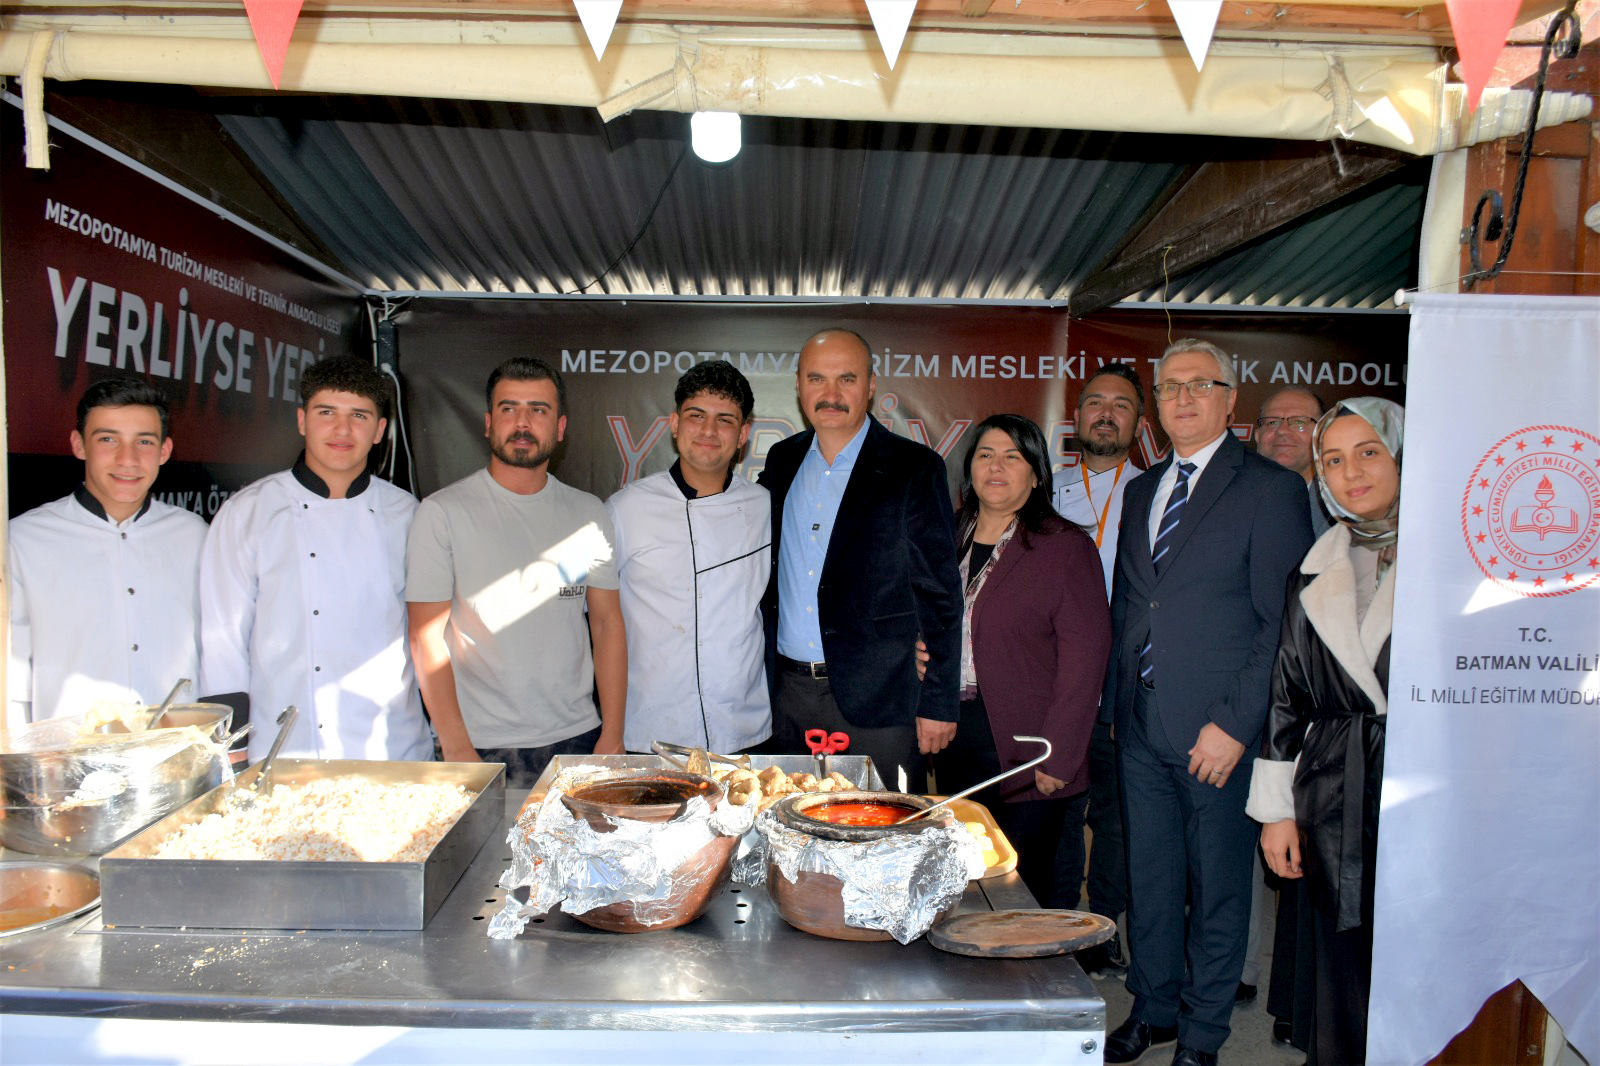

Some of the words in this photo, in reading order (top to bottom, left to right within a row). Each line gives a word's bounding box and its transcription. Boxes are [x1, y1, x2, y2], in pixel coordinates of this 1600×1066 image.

[45, 198, 157, 262] MEZOPOTAMYA
[160, 247, 202, 280] TURİZM
[204, 266, 244, 297] MESLEKİ
[245, 283, 257, 302] VE
[259, 289, 288, 314] TEKNİK
[288, 302, 323, 327] ANADOLU
[47, 266, 255, 394] YERLİYSE
[872, 348, 940, 378] RİZM
[952, 350, 1086, 379] MESLEKİ
[1269, 360, 1409, 386] ANADOL
[1492, 456, 1539, 523] CUMHURİYETİ
[1578, 470, 1600, 508] EĞİTİM
[1494, 526, 1528, 564] TÜRKİYE
[1554, 513, 1600, 564] BAKANLIĞI
[1518, 627, 1552, 642] T.C.
[1456, 655, 1531, 670] BATMAN
[1411, 685, 1426, 702] İL
[1431, 687, 1477, 704] MİLLÎ
[1480, 687, 1535, 704] EĞİTİM
